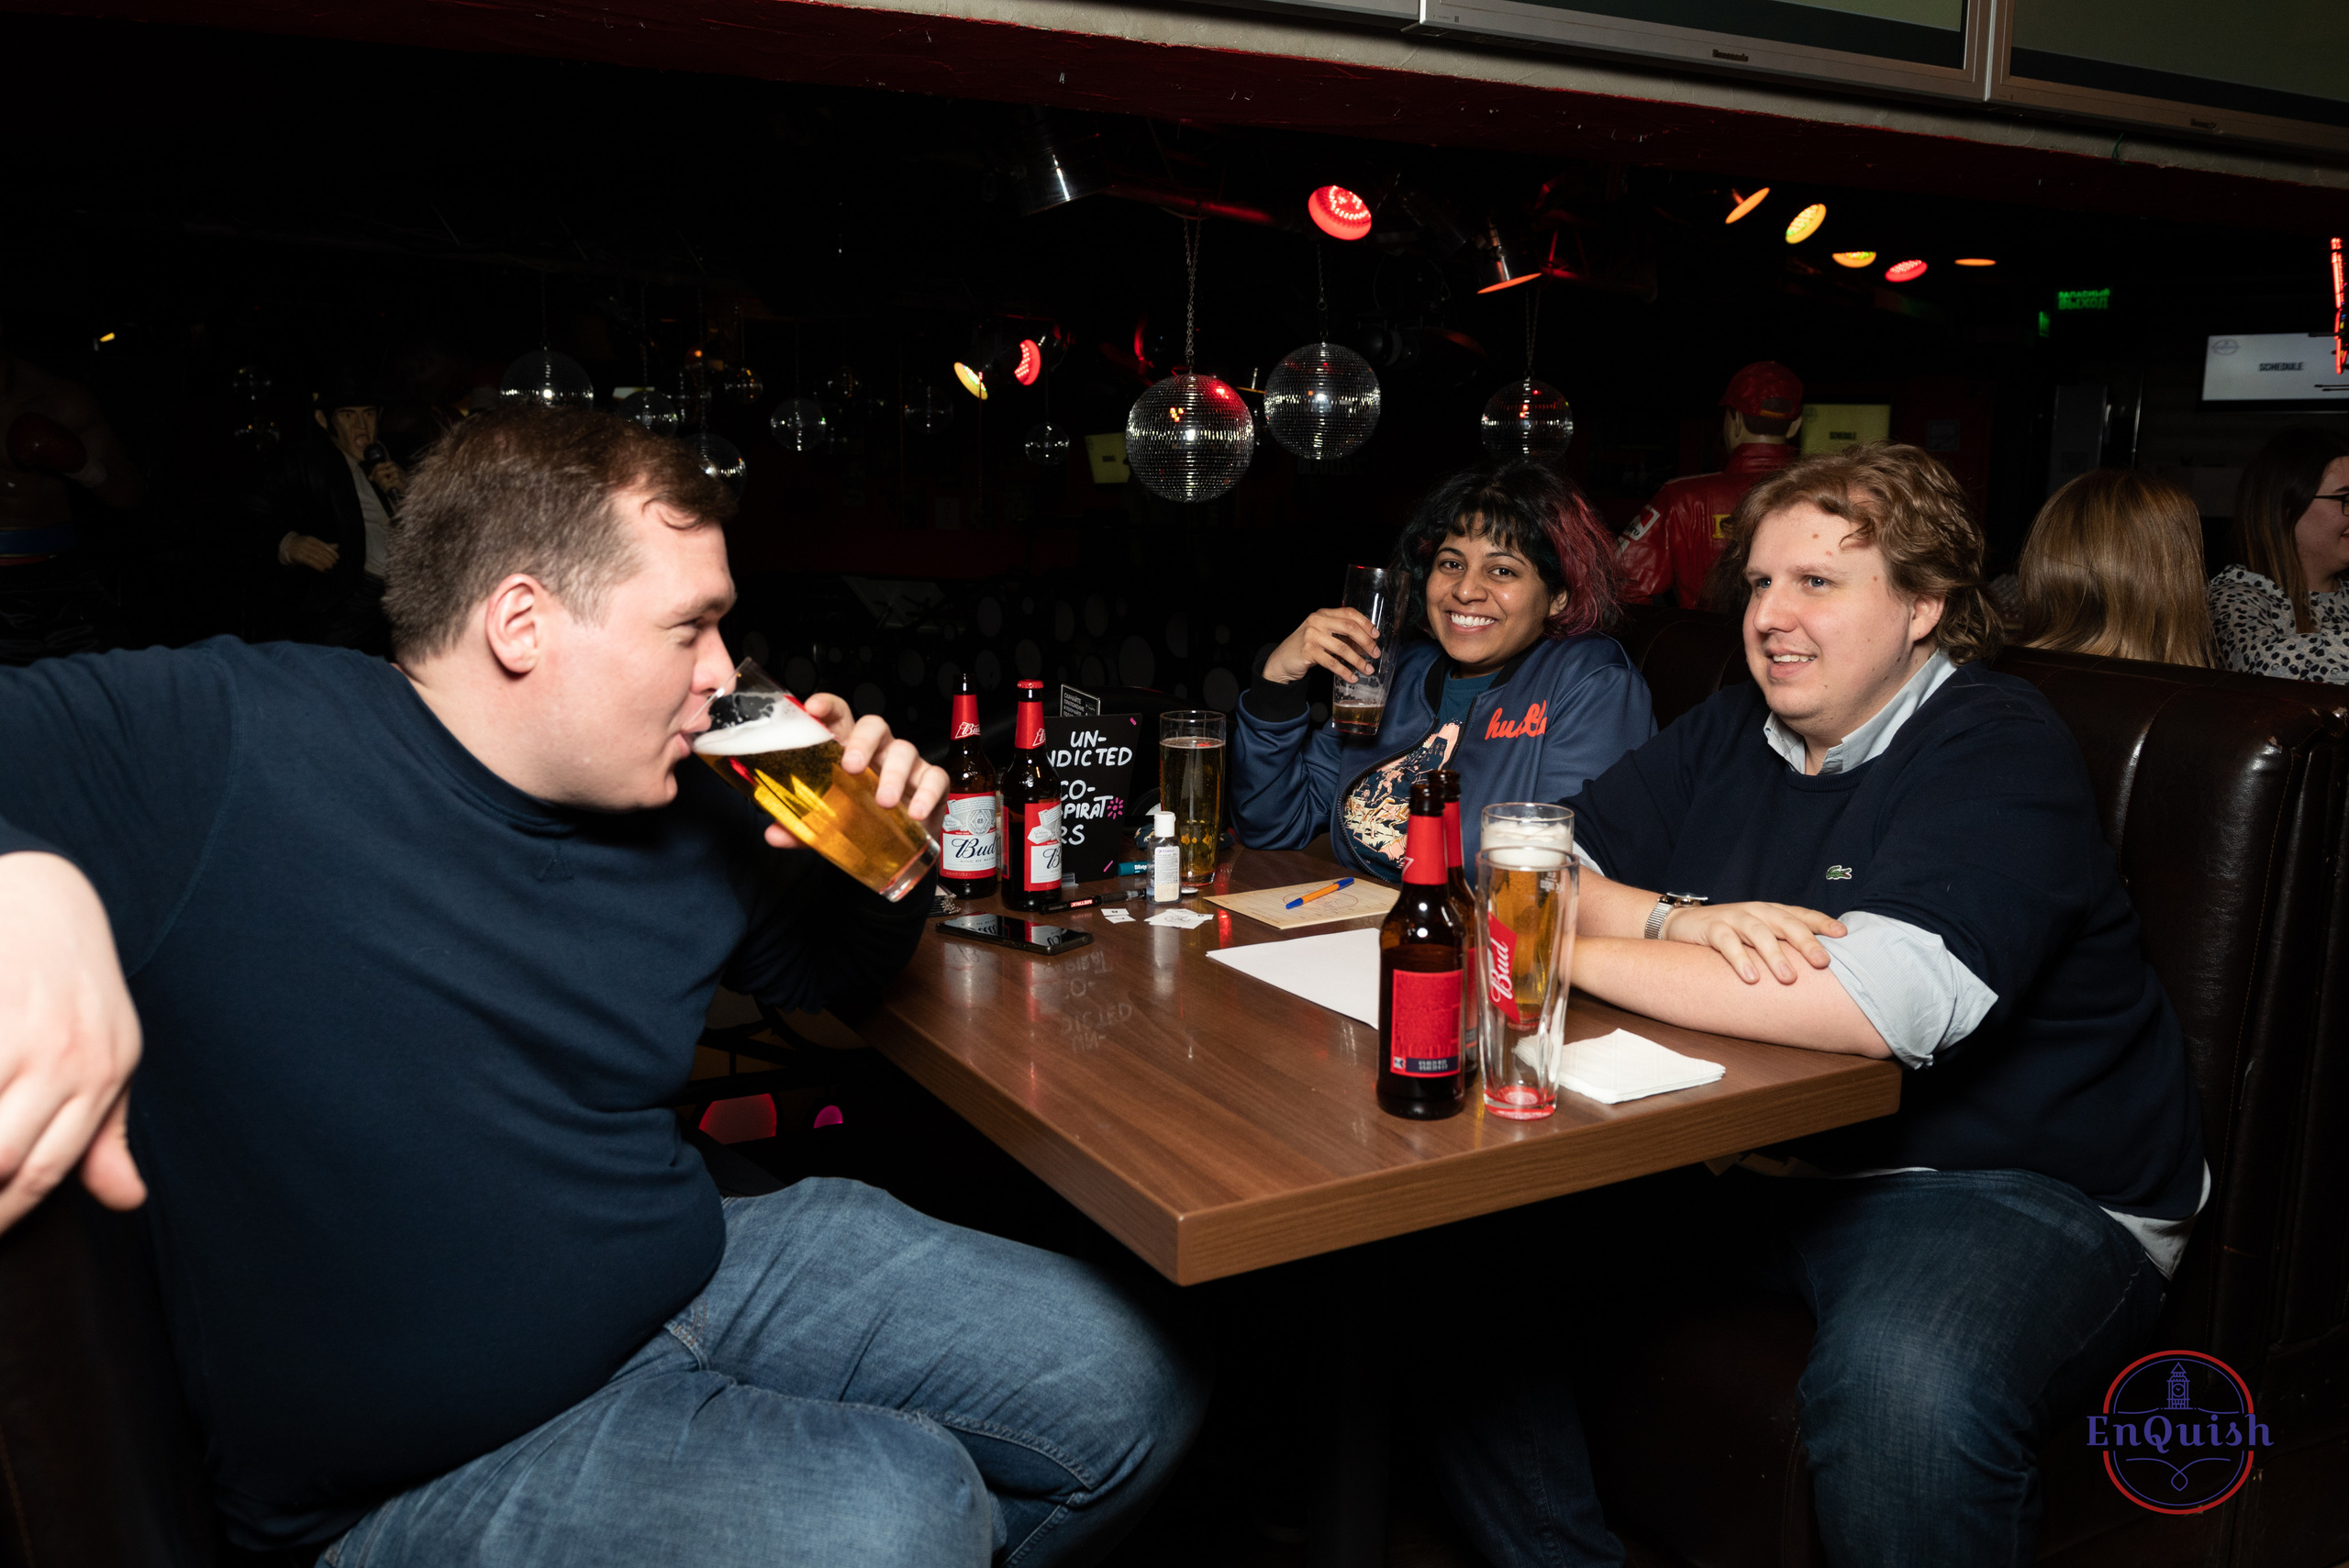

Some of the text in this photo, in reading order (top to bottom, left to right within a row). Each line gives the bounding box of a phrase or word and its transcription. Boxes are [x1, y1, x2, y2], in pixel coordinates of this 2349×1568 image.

[1070, 729, 1107, 748] UN-
[1047, 747, 1133, 767] NDICTED
[1061, 795, 1114, 819] PIRAT
[1061, 824, 1085, 846] RS
[952, 836, 996, 859] Bud
[1490, 937, 1513, 1003] Bud
